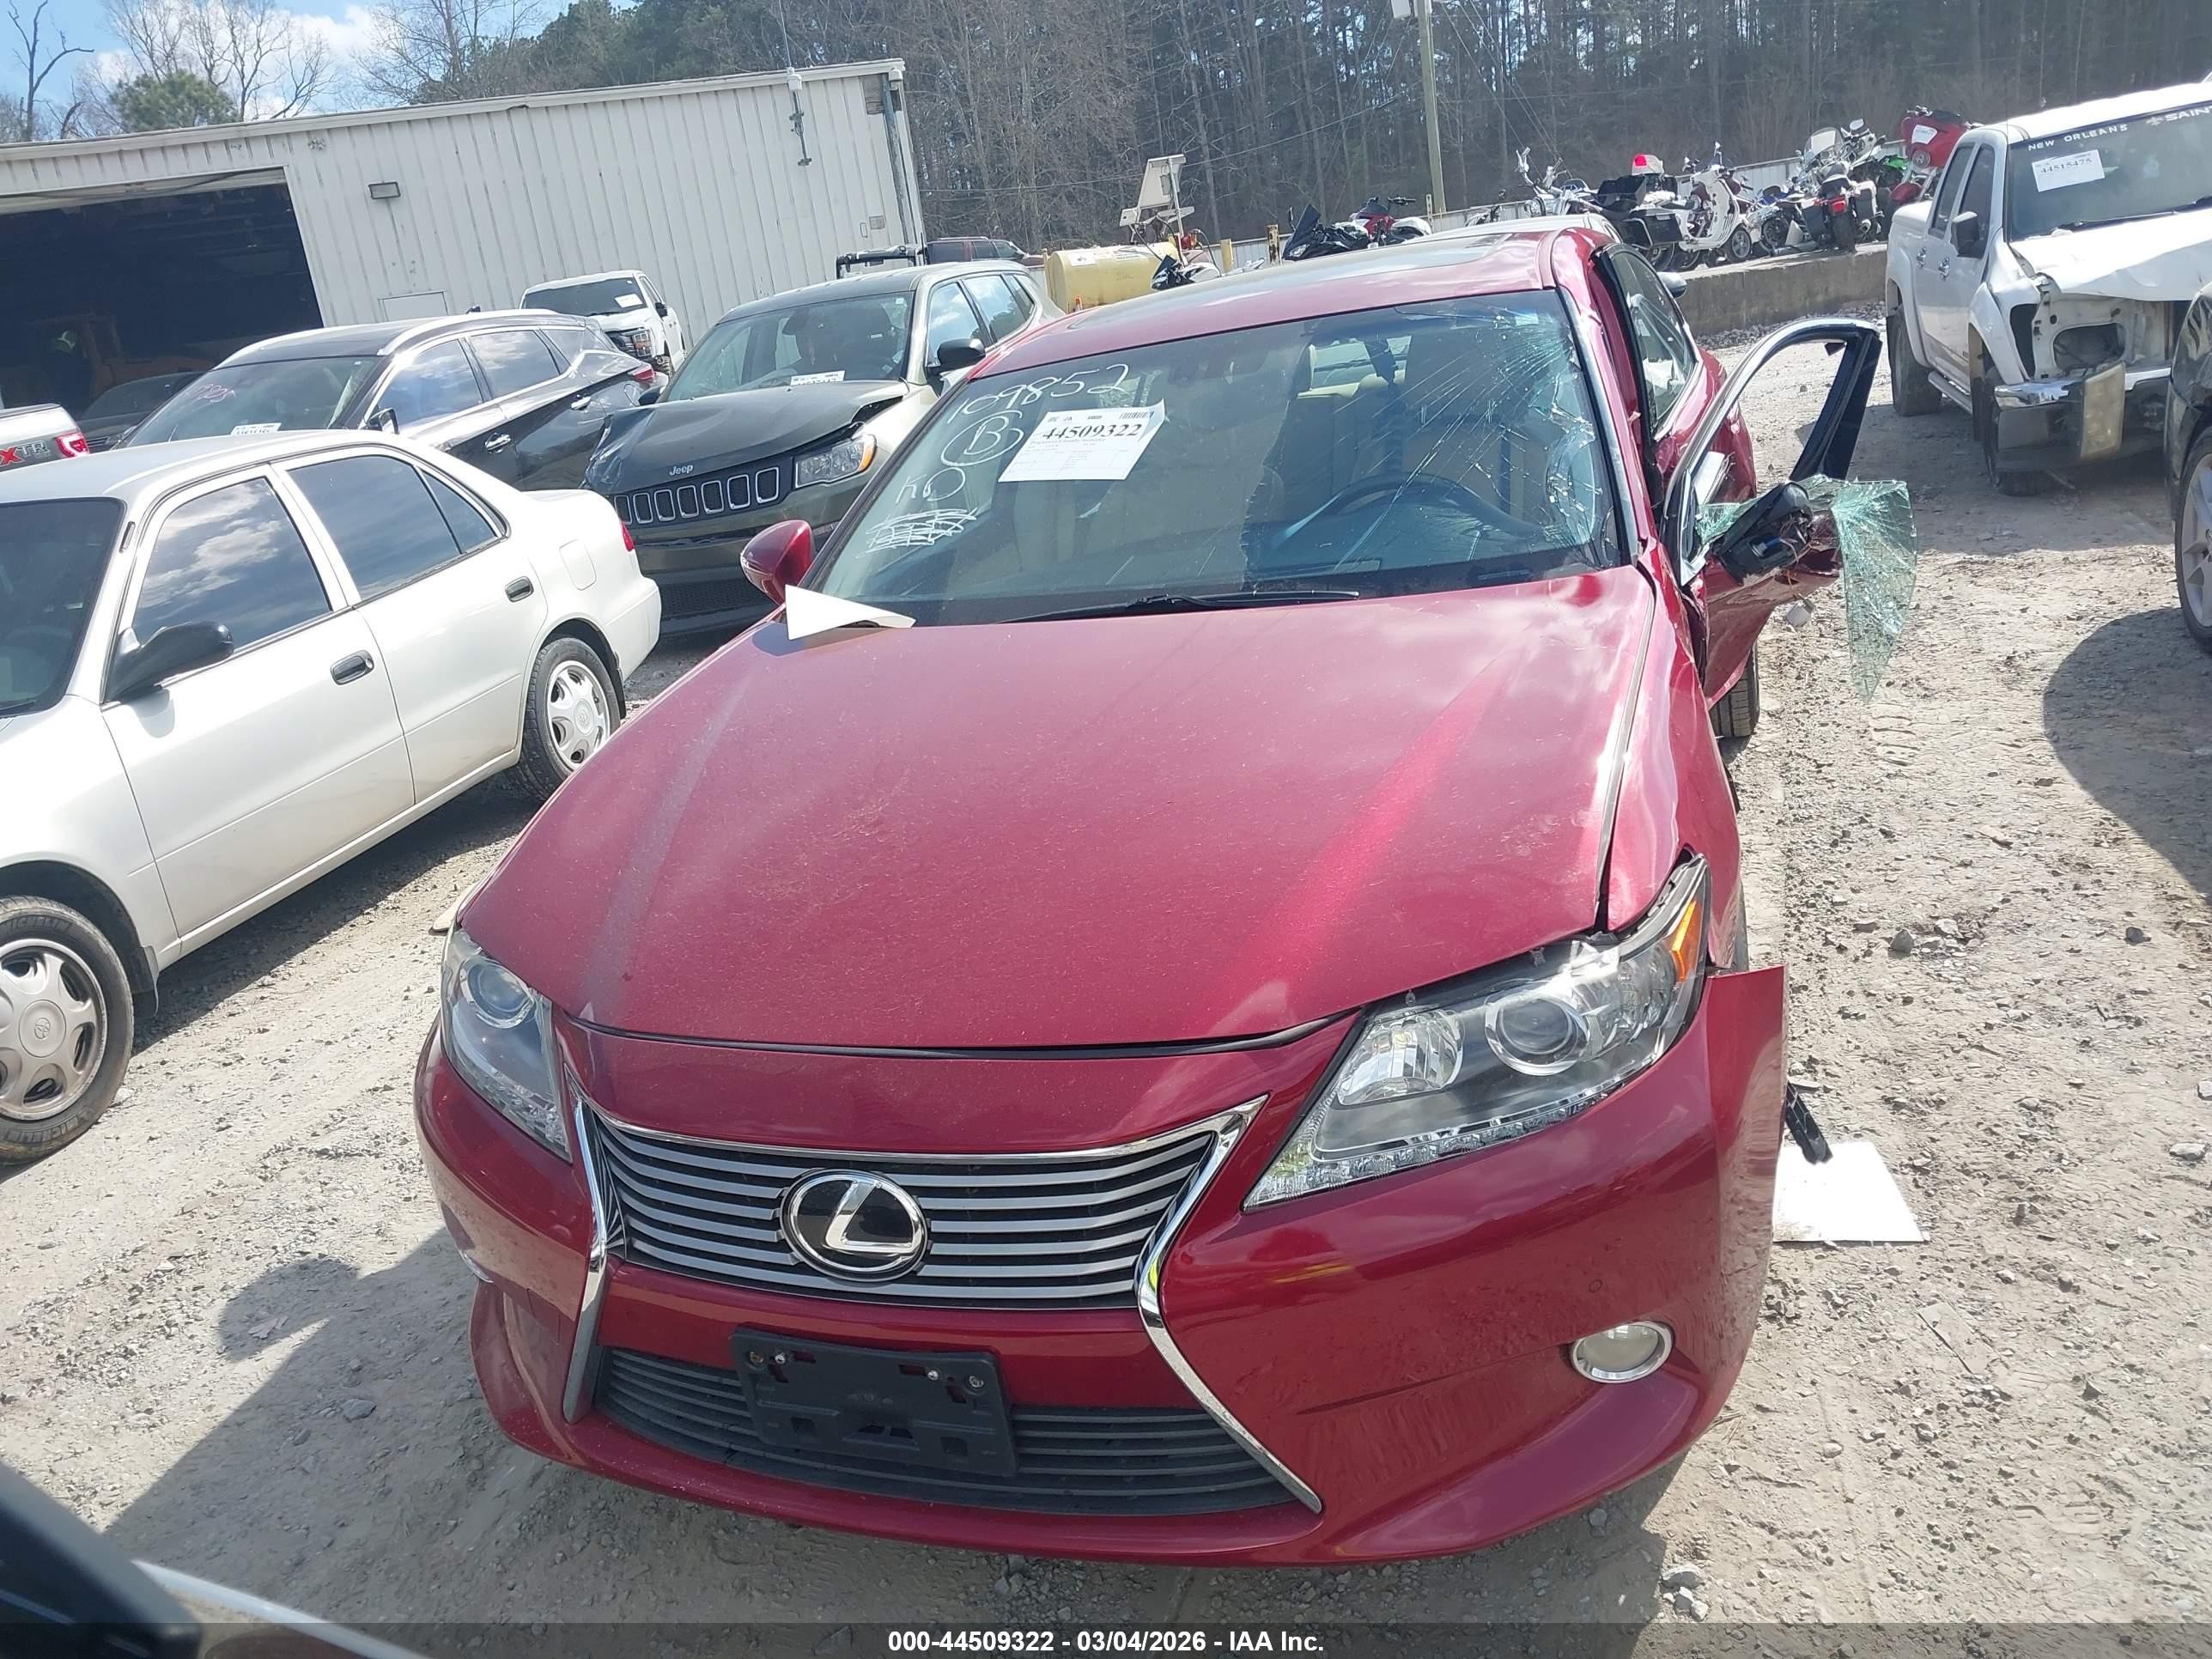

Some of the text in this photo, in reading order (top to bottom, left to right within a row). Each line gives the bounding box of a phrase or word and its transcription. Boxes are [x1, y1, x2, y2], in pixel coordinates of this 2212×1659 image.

[2028, 105, 2212, 151] NEW ORLEANS SAIN
[947, 363, 1130, 424] 109852
[963, 415, 1010, 455] B
[1042, 423, 1142, 439] 44509322
[669, 465, 694, 476] Jeep
